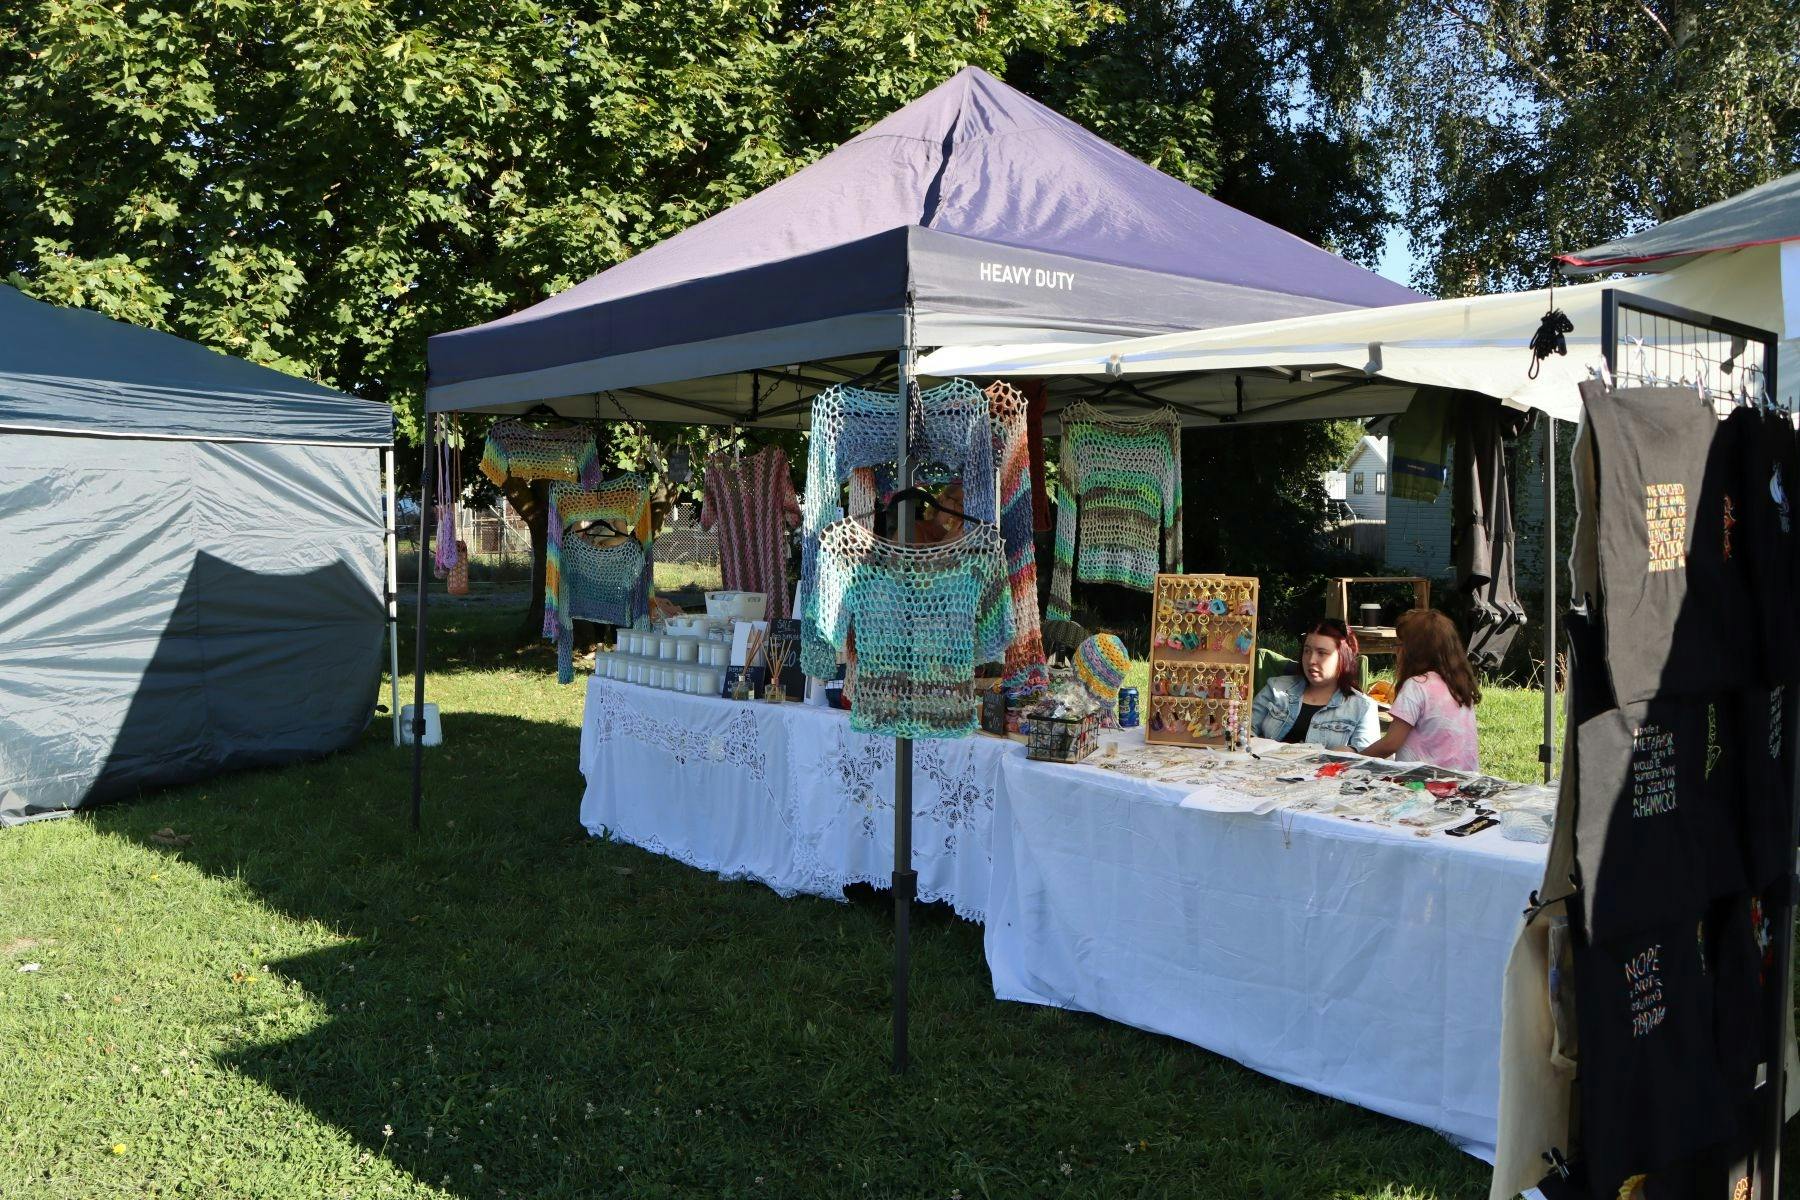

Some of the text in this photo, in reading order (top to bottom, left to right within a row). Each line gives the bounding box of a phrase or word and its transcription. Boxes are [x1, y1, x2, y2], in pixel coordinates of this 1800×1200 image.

[980, 262, 1075, 291] HEAVY DUTY
[1649, 540, 1684, 560] STATION
[1624, 944, 1663, 983] NOPE
